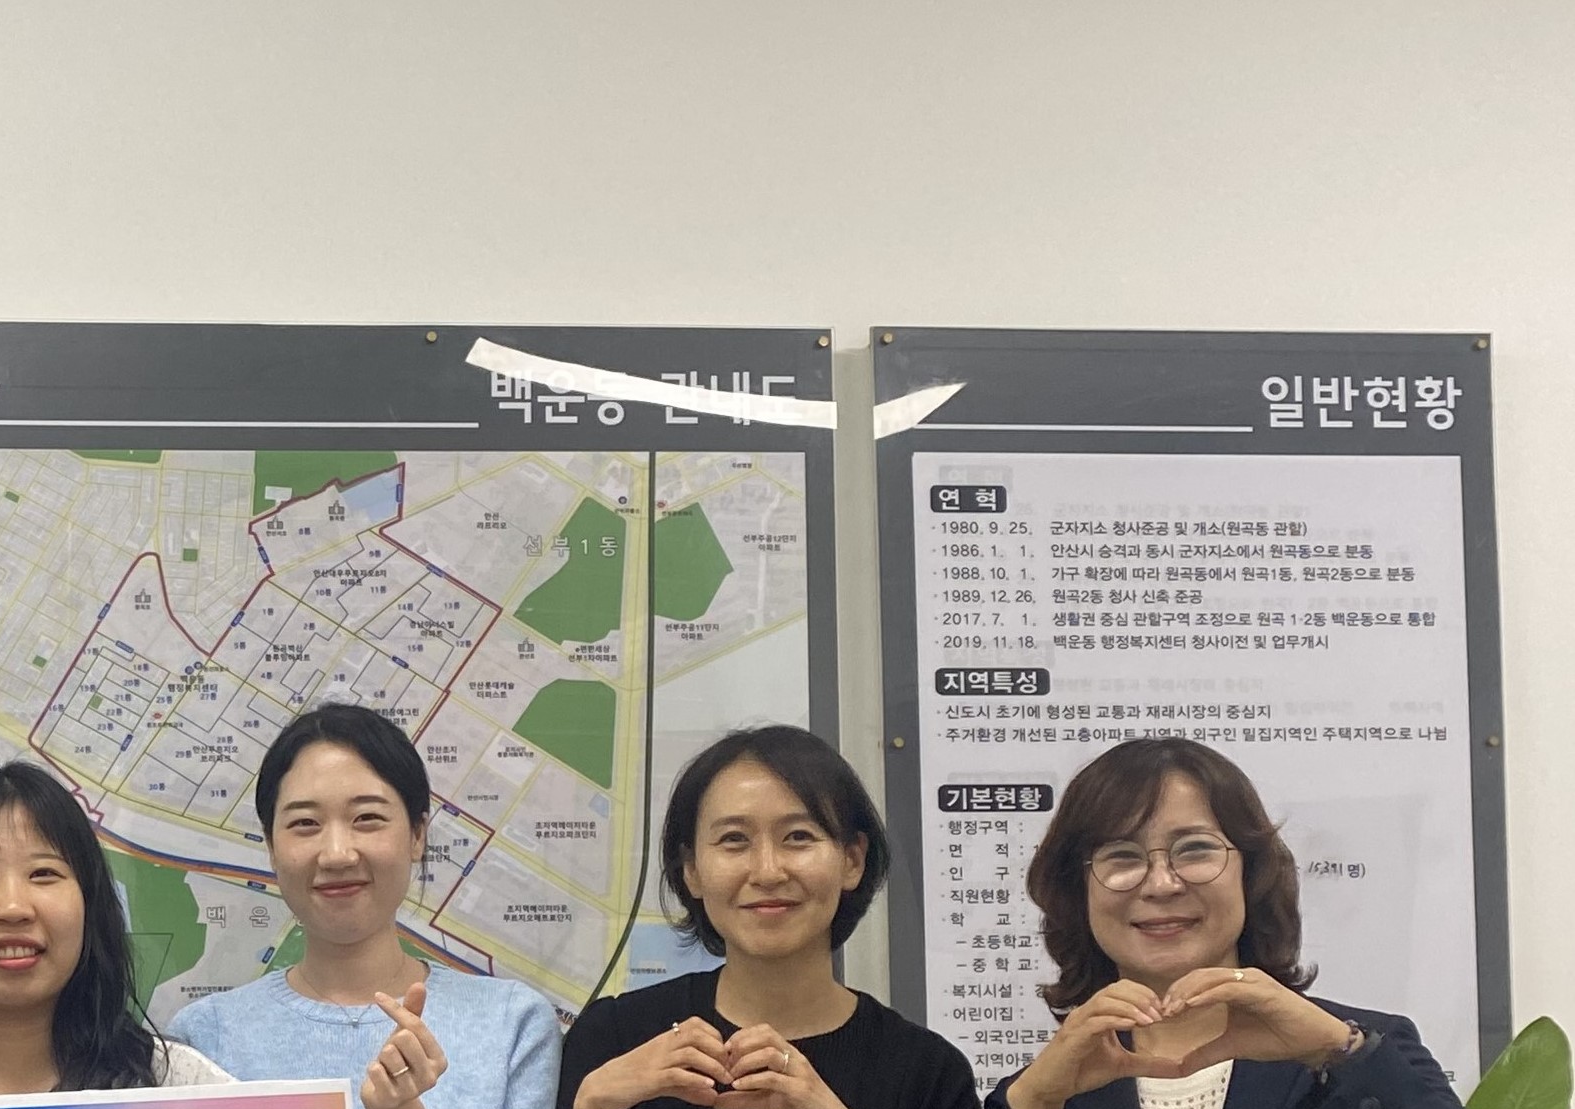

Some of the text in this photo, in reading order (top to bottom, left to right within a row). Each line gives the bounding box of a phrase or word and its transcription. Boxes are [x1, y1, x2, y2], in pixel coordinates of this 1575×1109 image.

[1261, 375, 1463, 431] 일반현황
[941, 520, 1308, 537] 1980. 9. 25. 군자지소 청사준공 및 개소(원곡동 관할)
[941, 543, 1374, 560] 1986. 1. 1. 안산시 승격과 동시 군자지소에서 원곡동으로 분동
[942, 565, 1416, 583] 1988. 10. 1. 가구 확장에 따라 원곡동에서 원곡1동, 원곡2동으로 분동
[942, 588, 1203, 605] 1989. 12. 26. 원곡2동 청사 신축 준공
[942, 612, 986, 627] 2017.
[991, 612, 1005, 627] 7.
[1021, 612, 1037, 627] 1.
[1052, 611, 1096, 627] 생활권
[1099, 611, 1129, 628] 중심
[1132, 611, 1191, 627] 관할구역
[1194, 612, 1253, 628] 조정으로
[1256, 611, 1286, 627] 원곡
[1330, 611, 1404, 628] 백운동으로
[1406, 611, 1436, 627] 통합
[943, 634, 1329, 651] 2019. 11. 18. 백운동 행정복지센터 청사이전 및 업무개시
[943, 671, 1038, 694] 지역특성
[945, 704, 1271, 721] 신도시 초기에 형성된 교통과 재래시장의 중심지
[945, 726, 1008, 744] 주거환경
[1011, 726, 1060, 744] 개선된
[1062, 726, 1137, 742] 고층아파트
[1192, 727, 1238, 744] 외구인
[1241, 727, 1319, 744] 밀집지역인
[1322, 726, 1414, 744] 주택지역으로
[946, 787, 1042, 811] 기본현황
[948, 819, 1009, 836] 행정구역
[949, 888, 1011, 905] 직원현황
[952, 983, 1012, 999] 복지시설
[952, 1006, 1013, 1022] 어린이집
[973, 1028, 1061, 1046] 외국인근로
